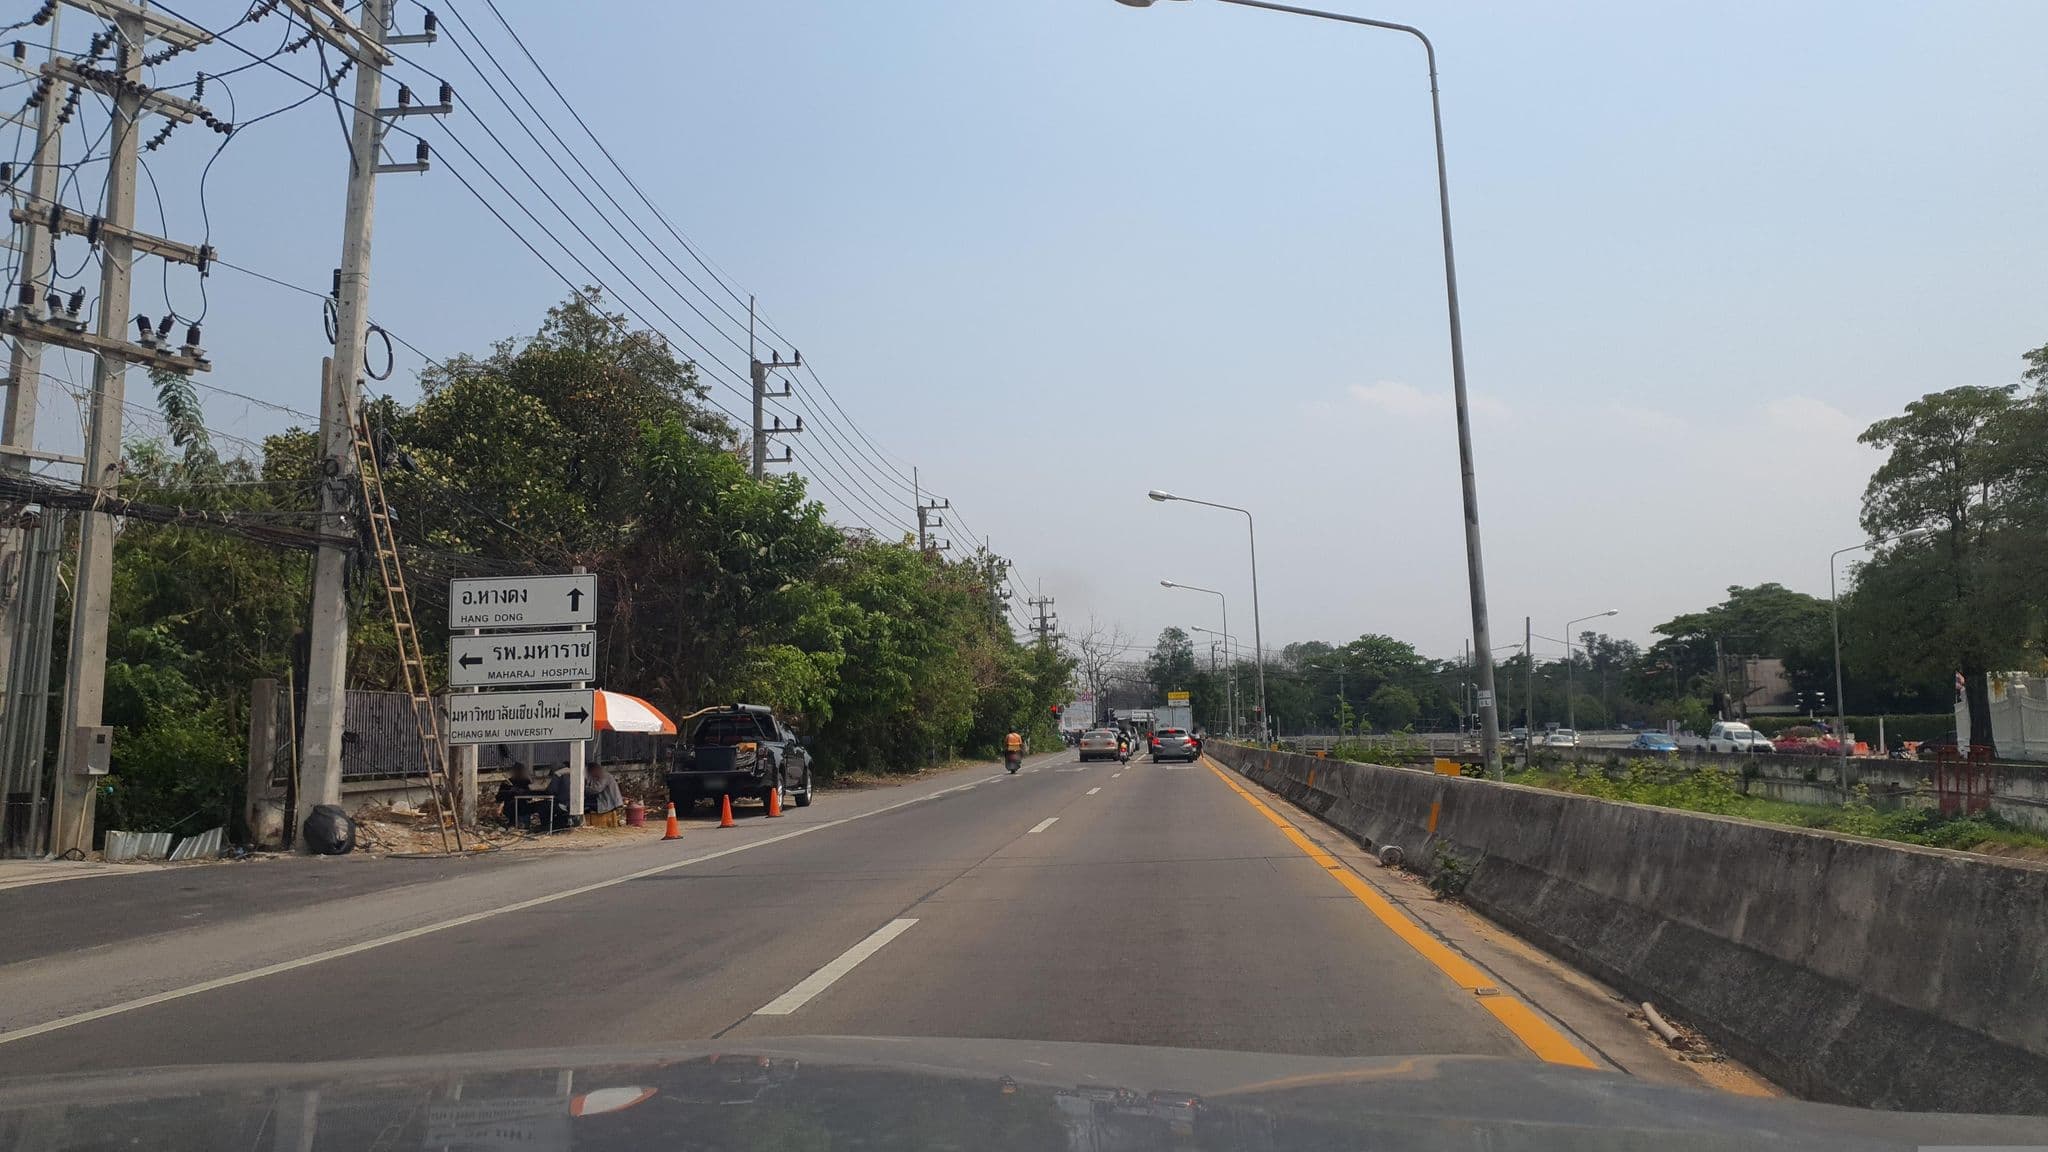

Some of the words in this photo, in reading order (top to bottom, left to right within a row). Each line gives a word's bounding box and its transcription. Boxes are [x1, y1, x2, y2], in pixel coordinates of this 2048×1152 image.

[462, 588, 528, 605] อ.หางดง
[461, 615, 489, 623] HANG
[494, 613, 523, 622] DONG
[493, 641, 591, 660] รพ.มหาราช
[488, 670, 536, 679] MAHARAJ
[541, 668, 590, 677] HOSPITAL
[452, 700, 560, 722] มหาวิทยาลัยเชียงใหม่
[451, 730, 483, 739] CHIANG
[484, 730, 500, 738] MAI
[504, 728, 554, 737] UNIVERSITY
